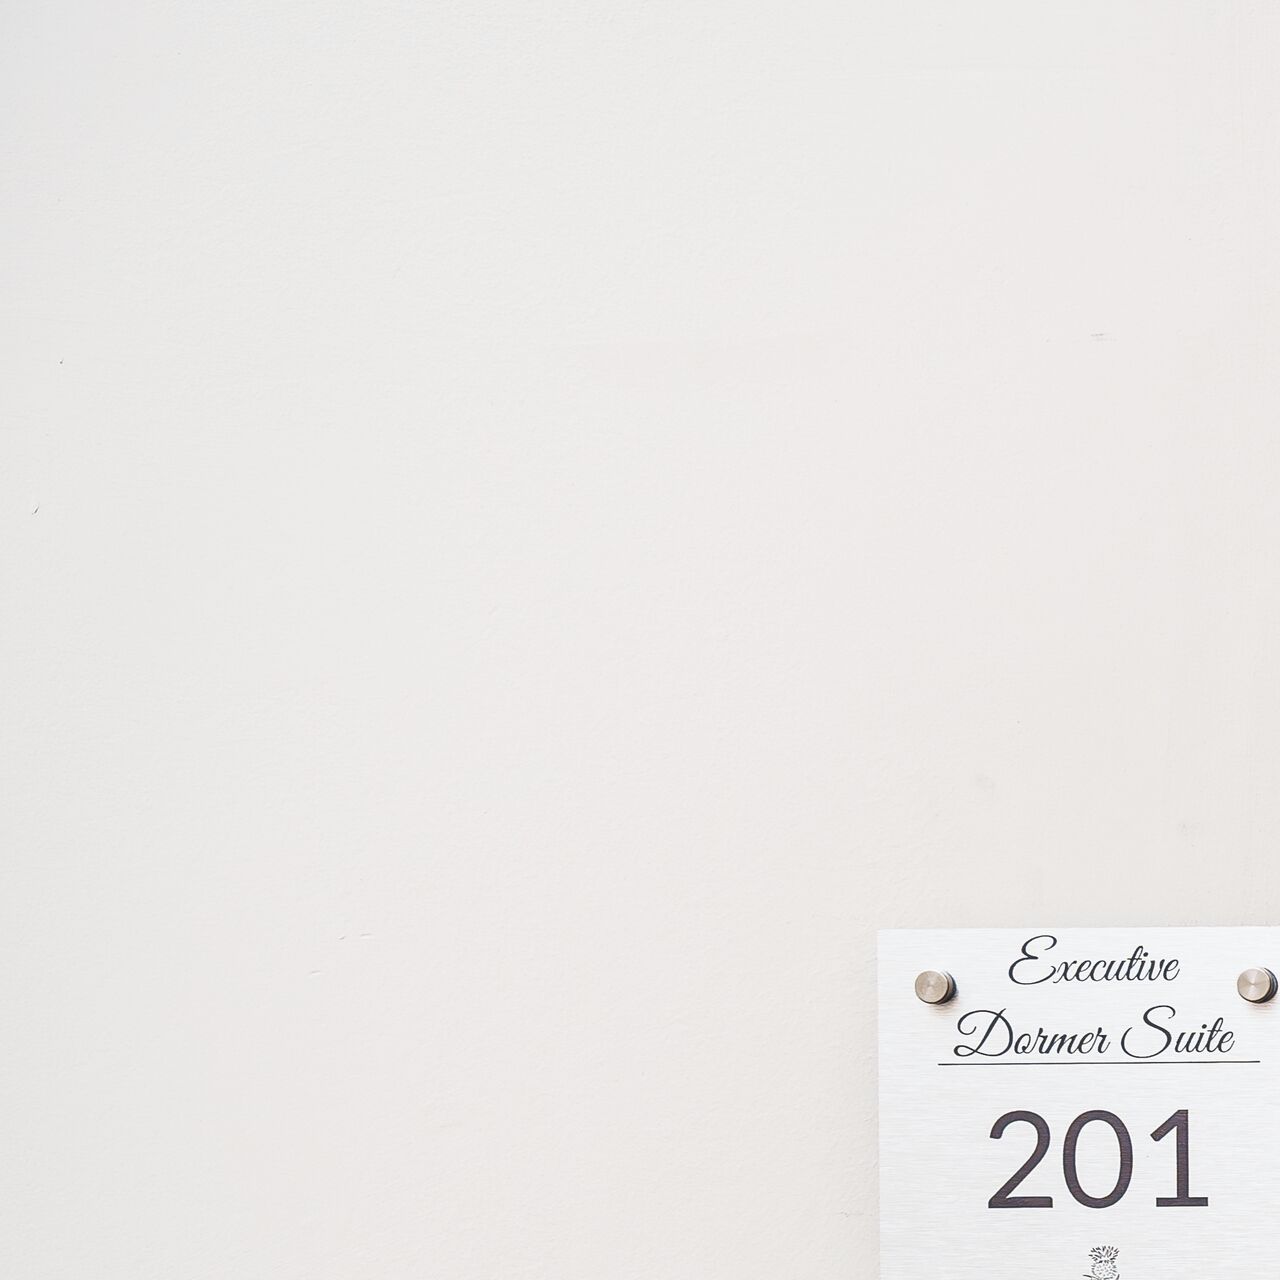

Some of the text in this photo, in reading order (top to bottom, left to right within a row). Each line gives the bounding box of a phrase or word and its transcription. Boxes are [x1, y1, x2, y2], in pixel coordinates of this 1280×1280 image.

[1008, 935, 1180, 985] Executive
[953, 1005, 1235, 1059] Dormer Suite
[988, 1109, 1209, 1209] 201
